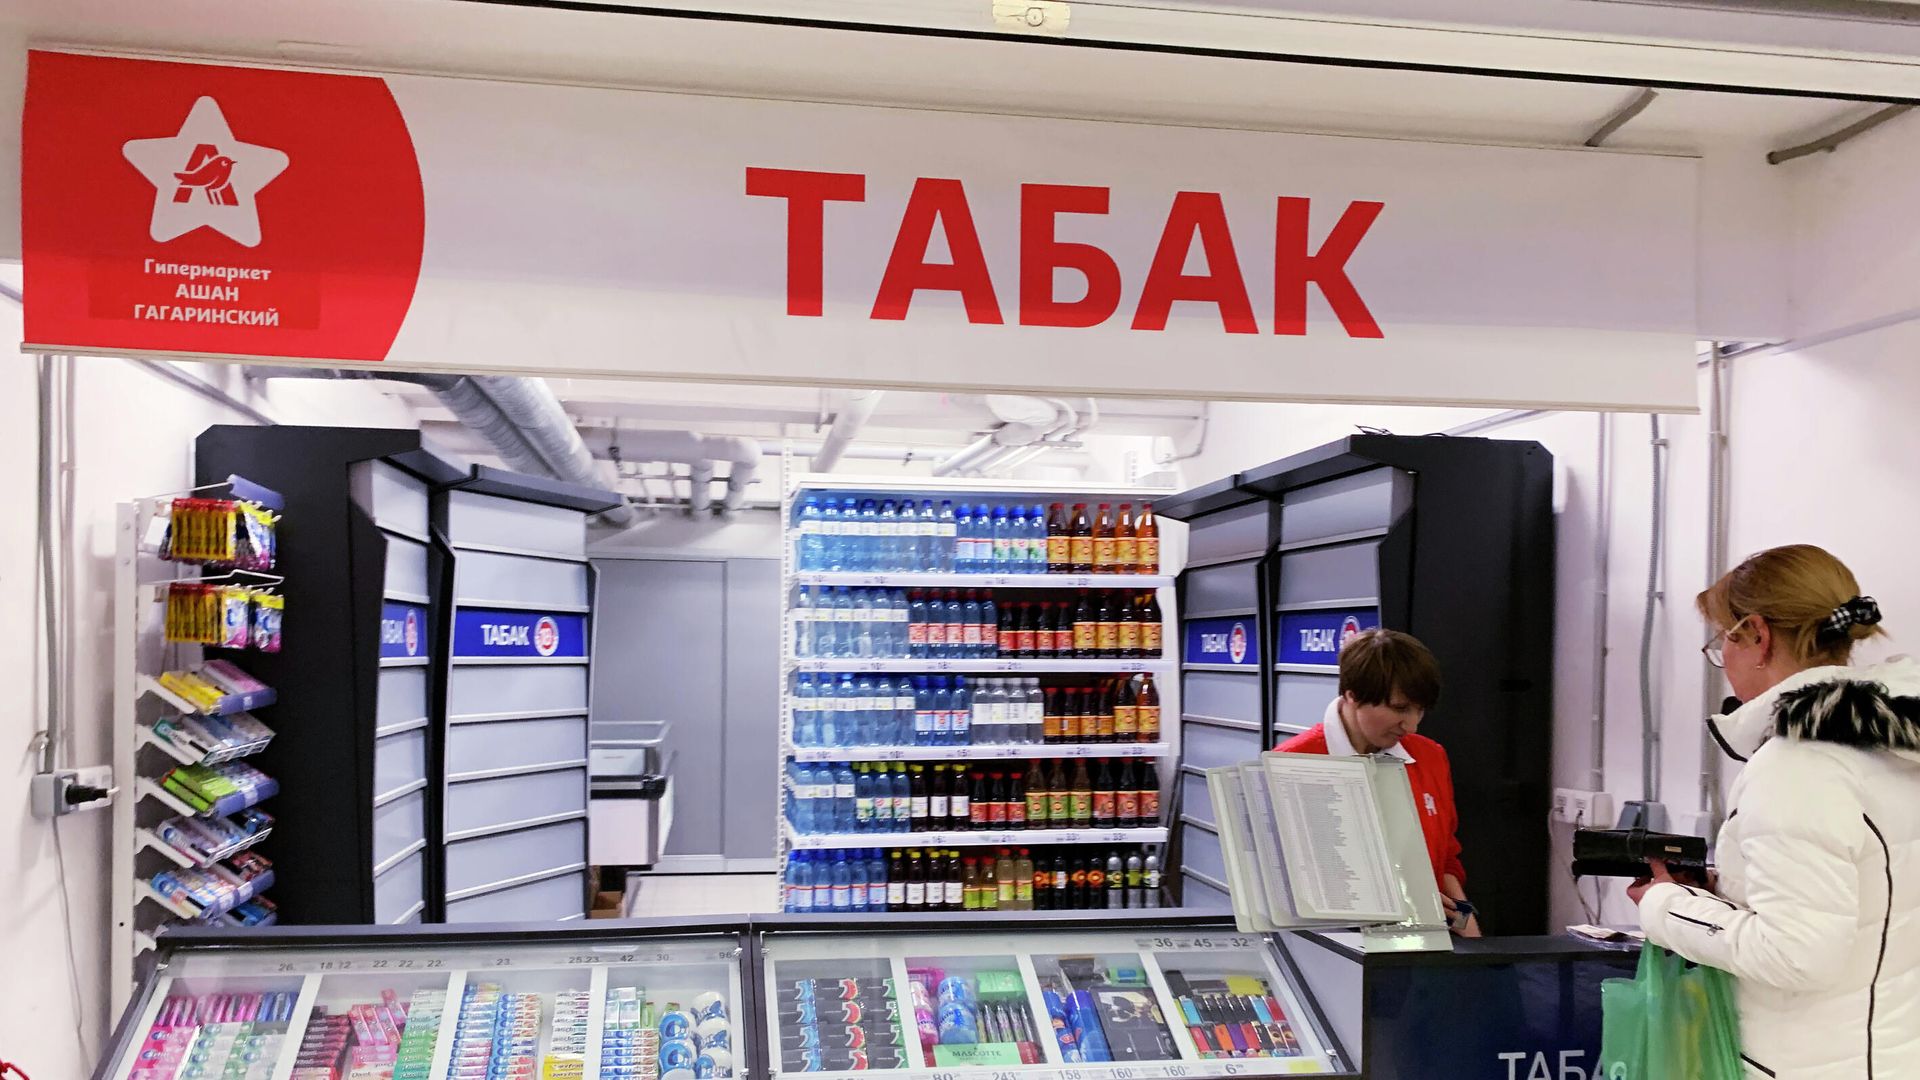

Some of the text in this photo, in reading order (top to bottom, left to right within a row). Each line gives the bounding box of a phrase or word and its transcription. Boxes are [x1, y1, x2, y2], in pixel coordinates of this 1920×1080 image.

[746, 167, 1384, 339] ТАБАК
[144, 258, 272, 281] Гипермаркет
[175, 284, 239, 302] АШАН
[134, 304, 279, 327] ГАГАРИНСКИЙ
[480, 624, 530, 646] ТАБАК
[1300, 628, 1336, 652] ТАБАК
[1154, 937, 1173, 948] 36
[1193, 938, 1213, 948] 45
[1231, 937, 1249, 947] 32
[496, 958, 511, 966] 23
[620, 954, 634, 962] 42
[657, 953, 669, 961] 30
[373, 960, 388, 968] 22
[398, 960, 413, 968] 22
[427, 959, 442, 968] 22
[1058, 1069, 1082, 1080] 158
[1109, 1067, 1133, 1079] 160
[1163, 1065, 1186, 1077] 160
[1225, 1063, 1237, 1075] 6
